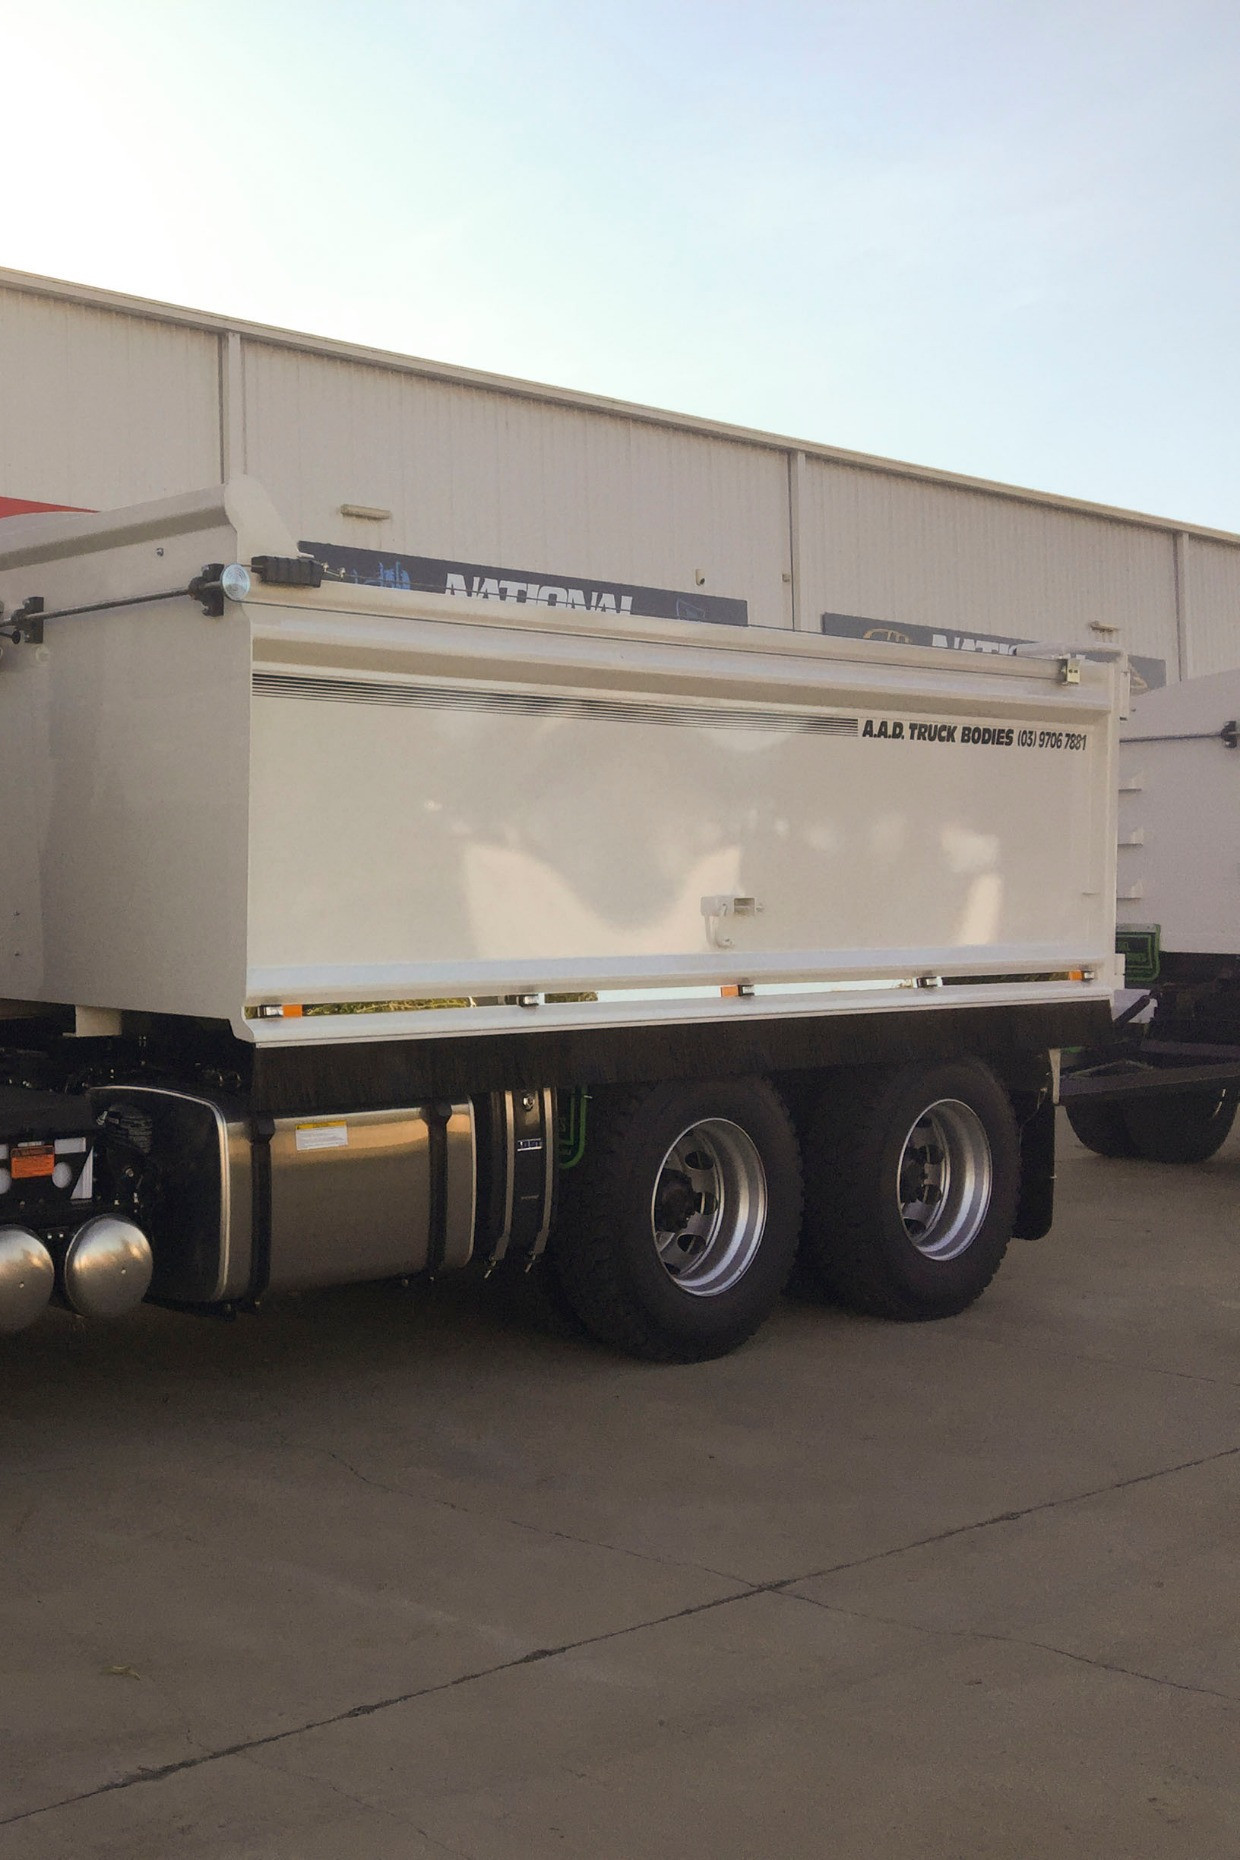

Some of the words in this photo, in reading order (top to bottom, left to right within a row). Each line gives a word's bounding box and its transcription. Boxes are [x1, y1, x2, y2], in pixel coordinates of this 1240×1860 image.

[862, 719, 905, 740] A.A.D.
[908, 723, 958, 743] TRUCK
[960, 726, 1015, 747] BODIES
[1017, 729, 1038, 748] (03)
[1038, 731, 1063, 749] 9706
